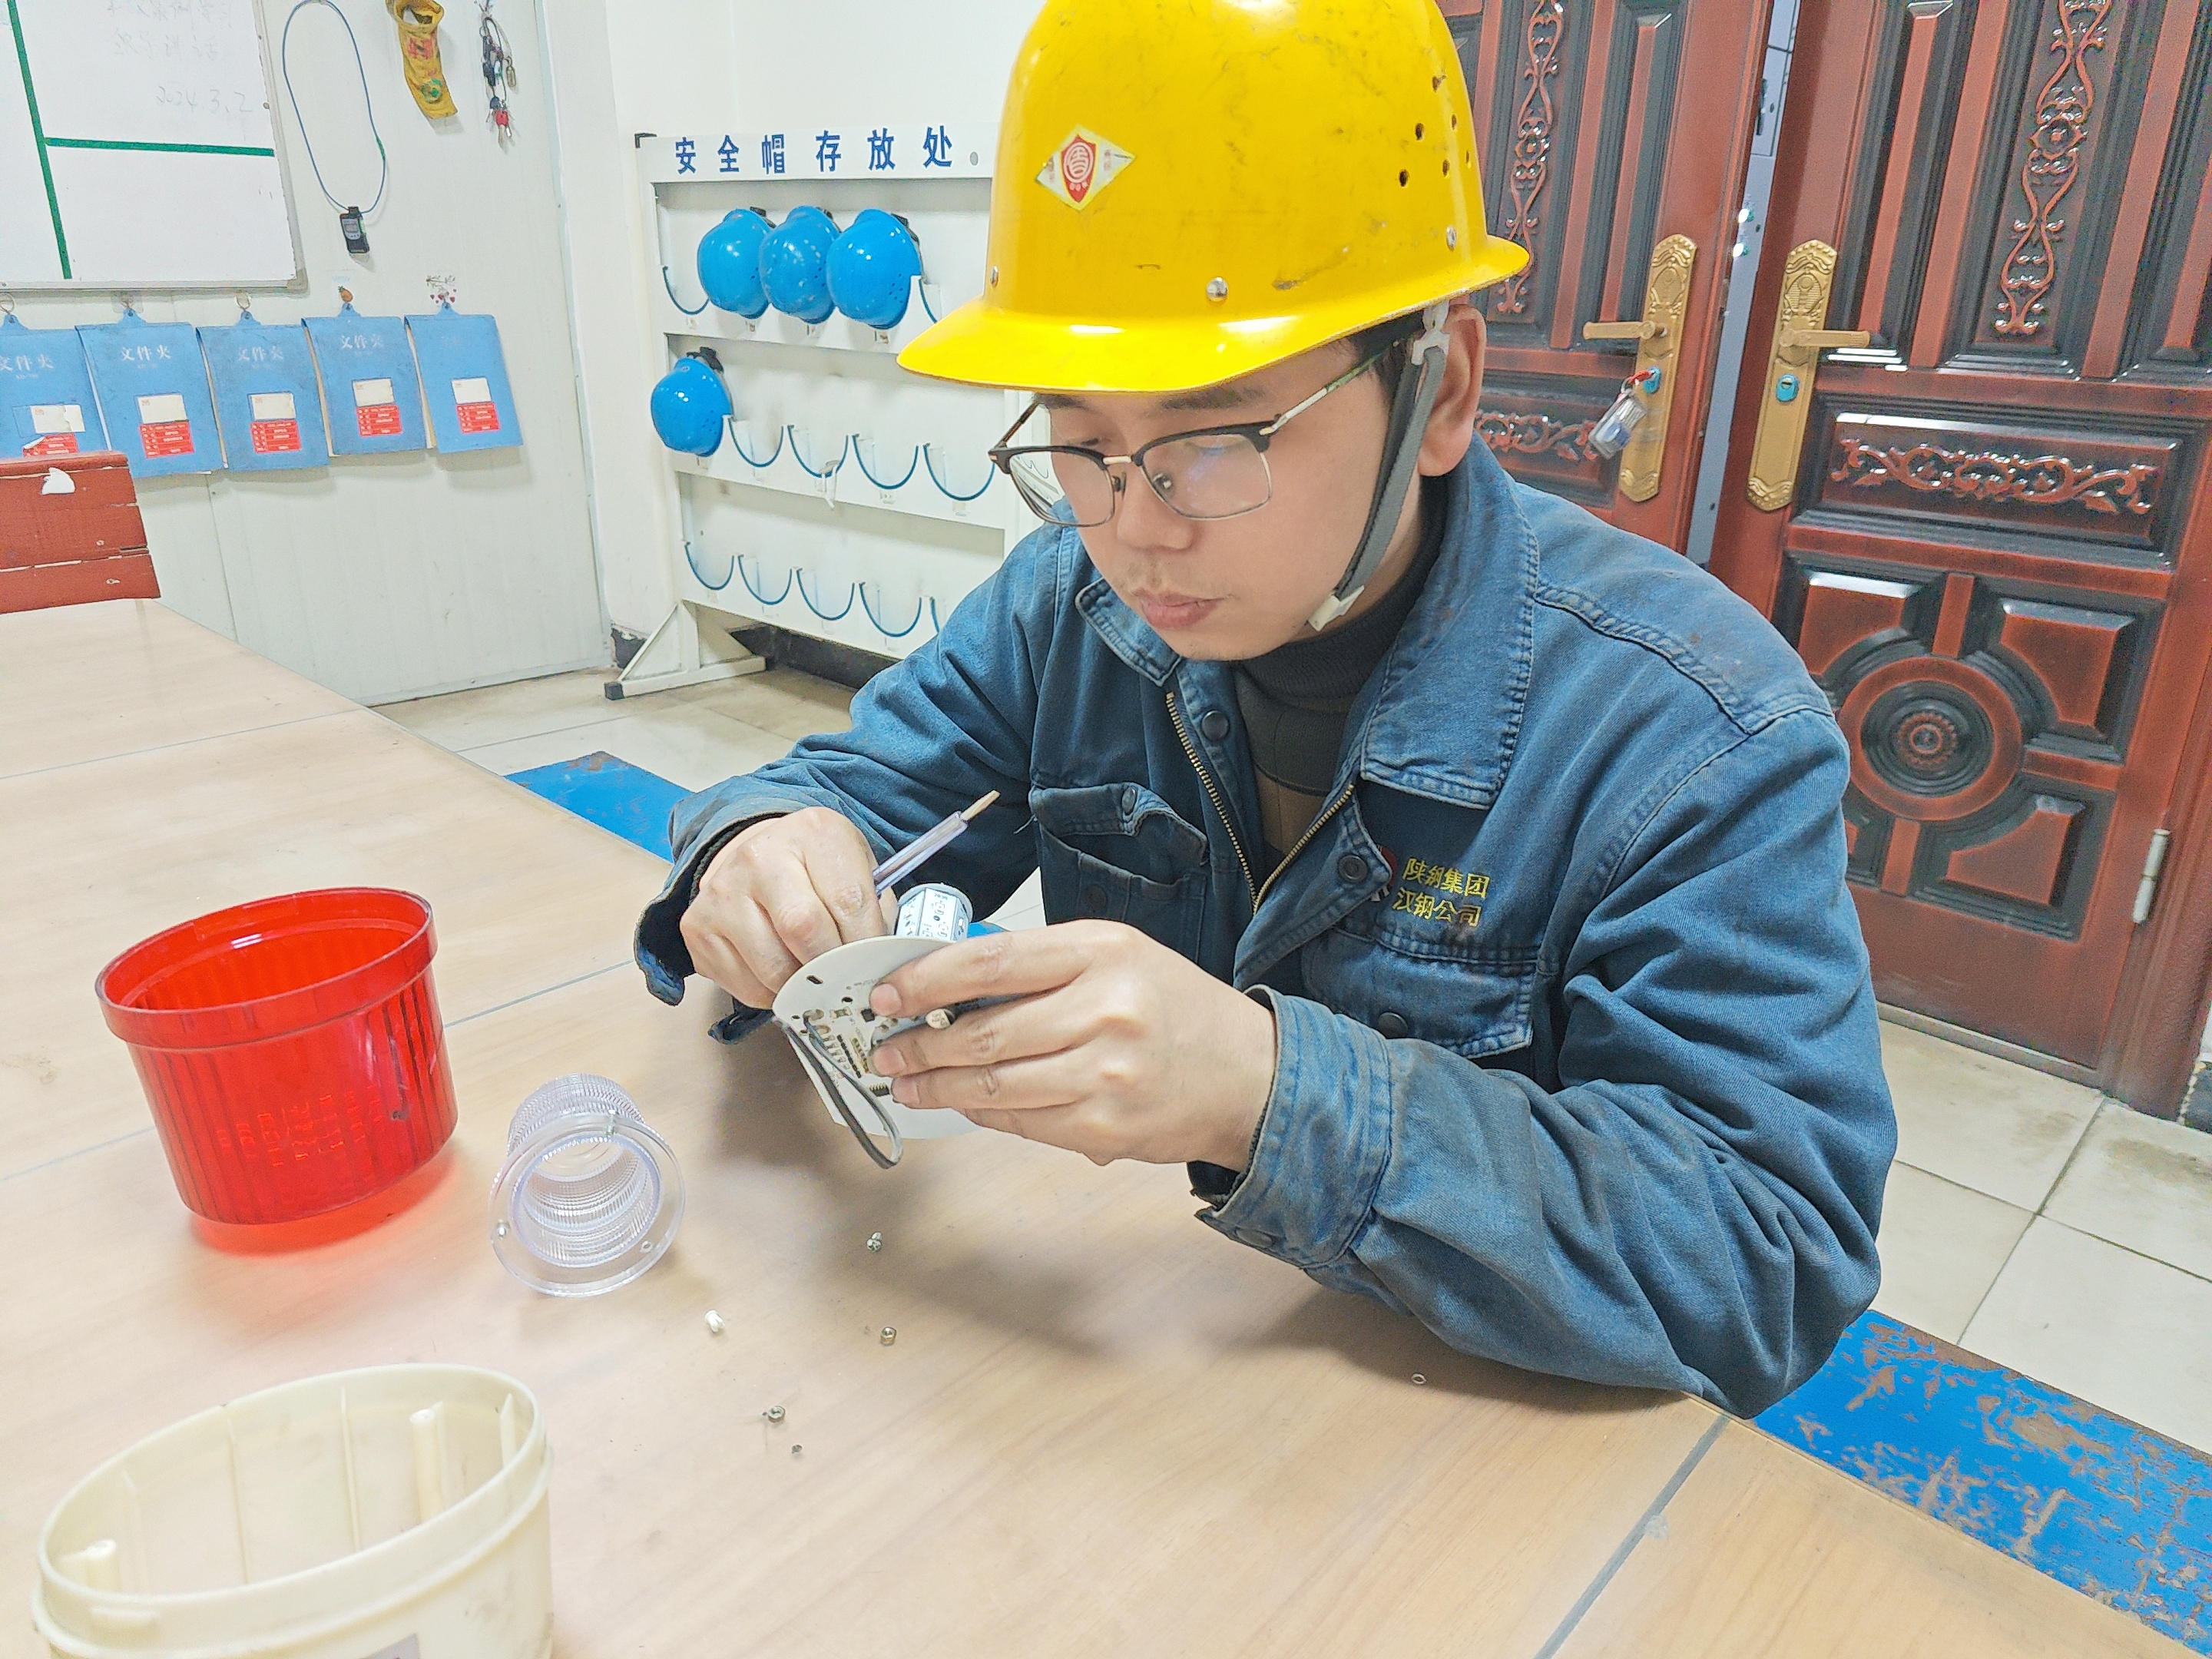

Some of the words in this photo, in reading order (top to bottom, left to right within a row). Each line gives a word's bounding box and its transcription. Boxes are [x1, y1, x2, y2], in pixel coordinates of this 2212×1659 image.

[674, 124, 954, 175] 安全帽存放处
[121, 344, 171, 361] 文件夹
[1402, 857, 1490, 899] 陕钢集团
[1392, 886, 1482, 928] 汉钢公司
